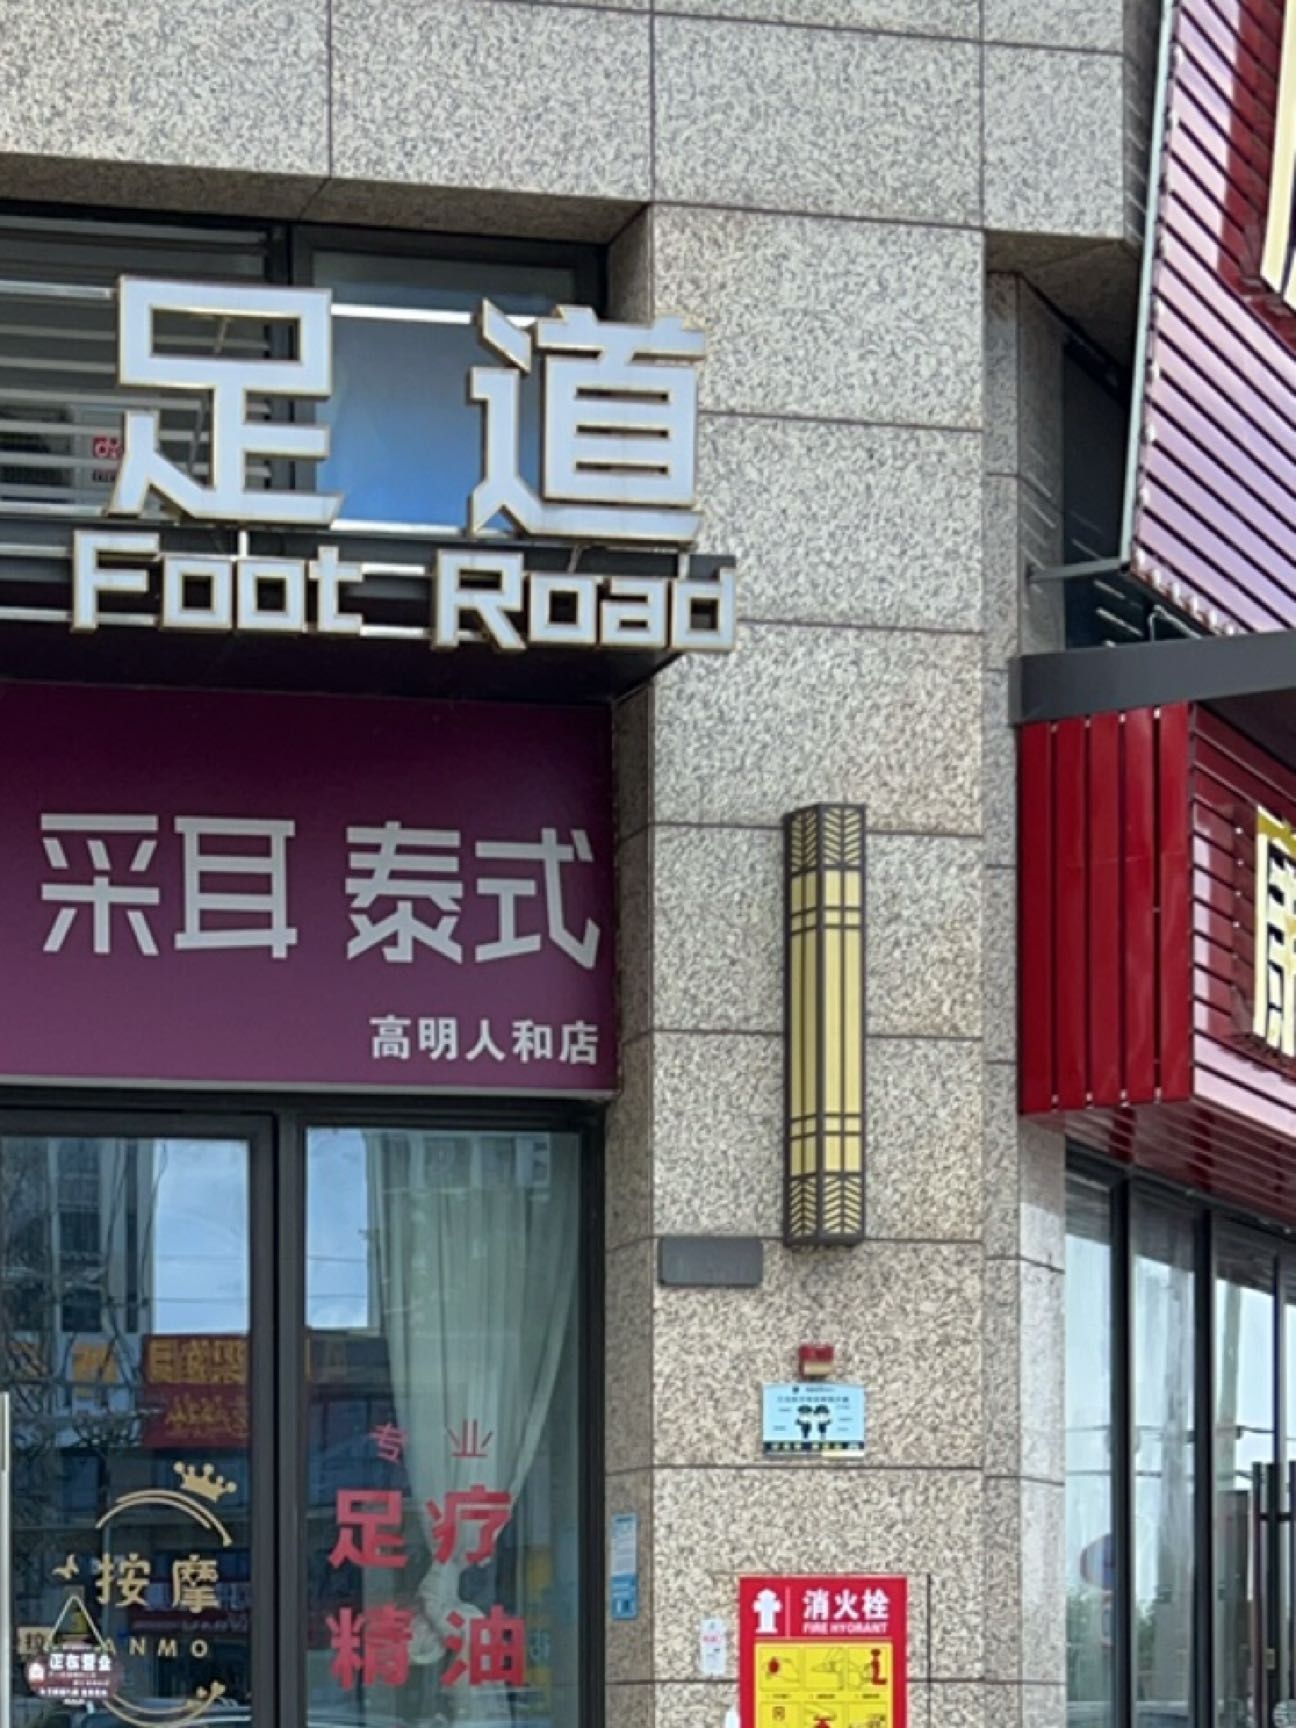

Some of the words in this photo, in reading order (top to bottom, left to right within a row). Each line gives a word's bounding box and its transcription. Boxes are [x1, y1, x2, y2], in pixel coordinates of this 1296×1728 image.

[71, 529, 364, 633] Foot
[431, 548, 736, 651] Road
[40, 812, 298, 959] 采耳
[345, 820, 600, 970] 泰式
[368, 1014, 599, 1065] 高明人和店
[329, 1485, 513, 1569] 足疗
[96, 1553, 219, 1613] 按摩
[803, 1588, 889, 1620] 消火栓
[326, 1605, 529, 1690] 精油
